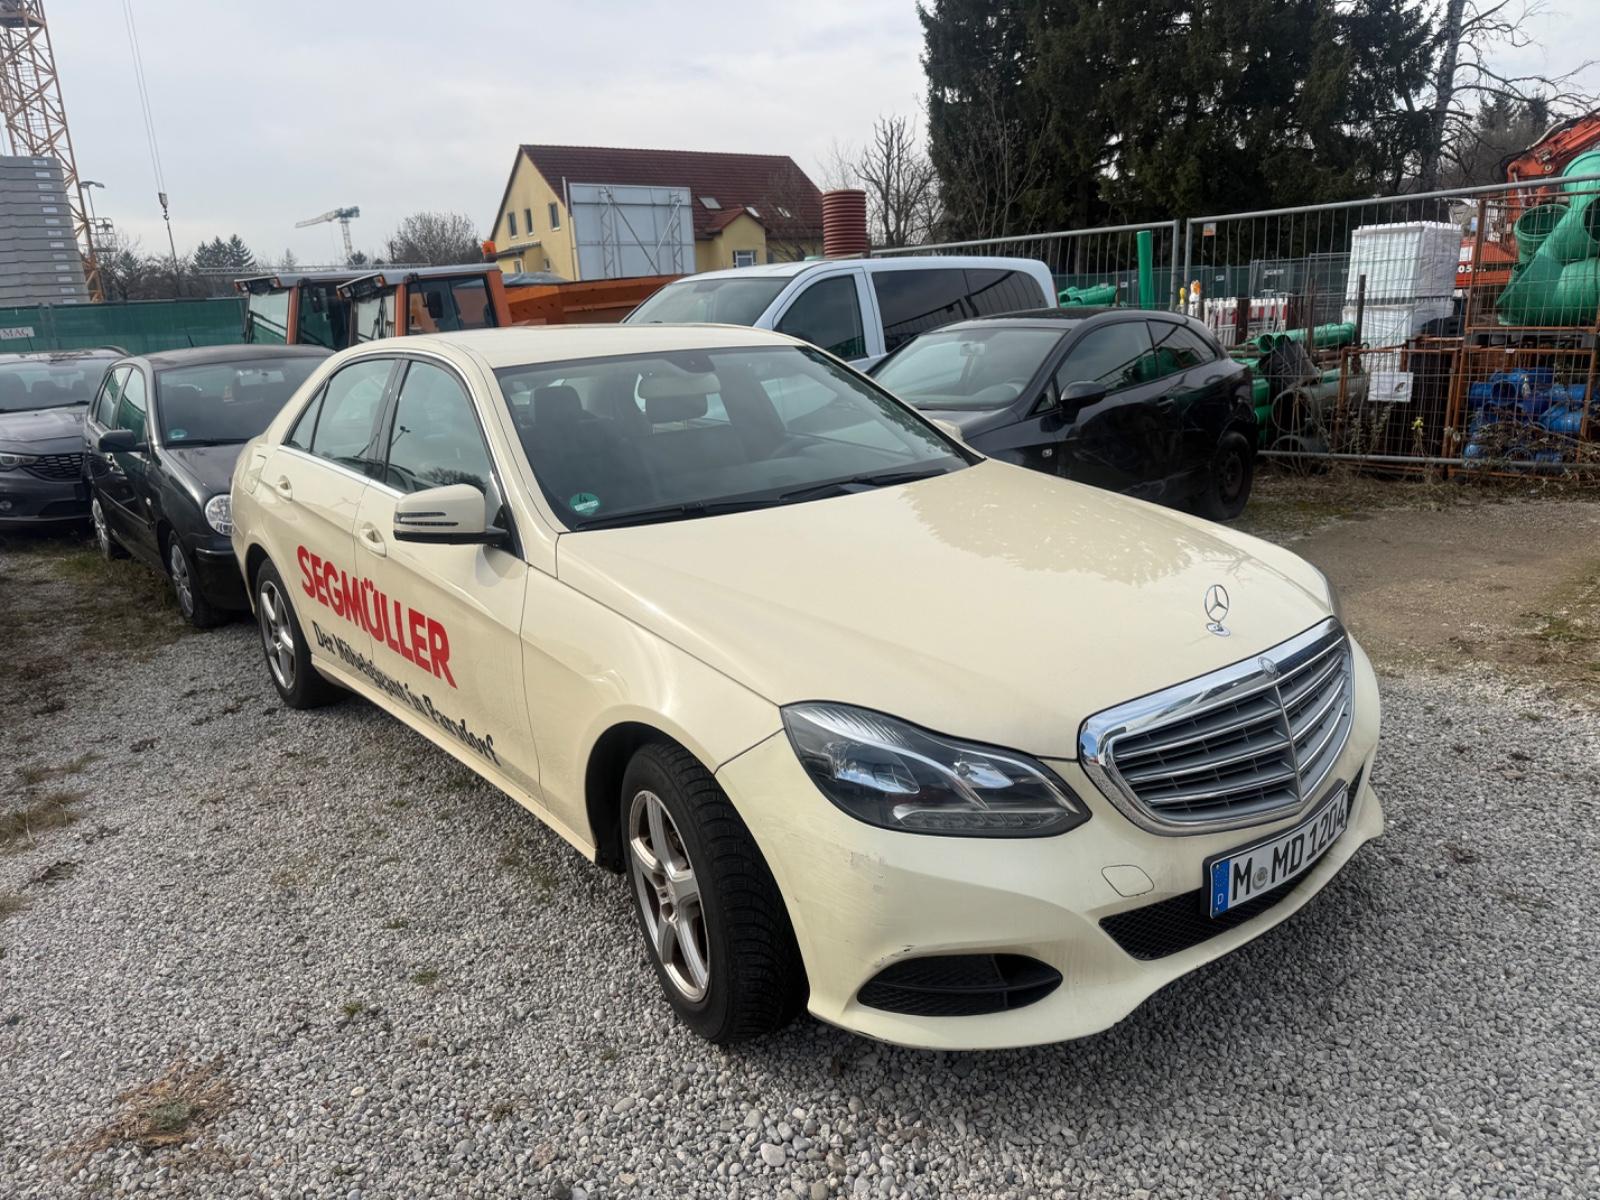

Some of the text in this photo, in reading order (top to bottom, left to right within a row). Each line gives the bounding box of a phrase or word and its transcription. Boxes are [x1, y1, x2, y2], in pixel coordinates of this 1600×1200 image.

[297, 545, 458, 690] SEGMÜLLER
[312, 619, 336, 655] Der
[422, 693, 502, 767] Parsdorf
[1217, 892, 1224, 905] D
[1232, 793, 1346, 901] M MD 1204
